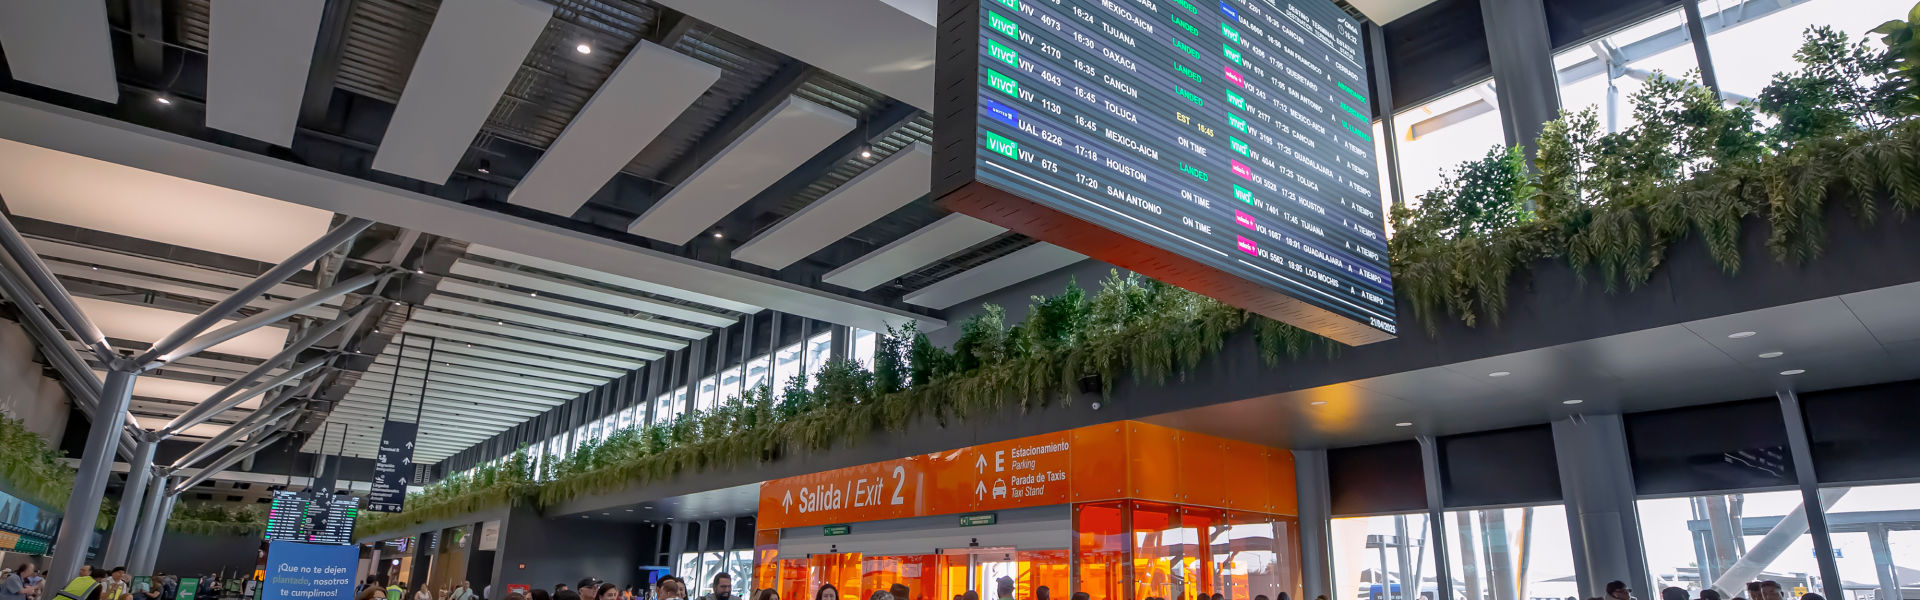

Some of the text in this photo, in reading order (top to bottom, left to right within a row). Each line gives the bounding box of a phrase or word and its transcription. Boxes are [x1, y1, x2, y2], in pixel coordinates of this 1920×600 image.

[1102, 0, 1153, 34] MEXICO-AICM
[1173, 37, 1200, 60] LANDED
[1172, 14, 1199, 37] LANDED
[1019, 1, 1204, 108] VIV 4073 16:30 OAXACA LANDED
[1073, 6, 1094, 24] 16:24
[1103, 22, 1136, 48] TIJUANA
[1174, 61, 1202, 84] LANDED
[1019, 30, 1034, 46] VIV
[1042, 42, 1061, 60] 2170
[1074, 59, 1095, 78] 16:35
[1104, 74, 1138, 99] CANCUN
[1177, 112, 1190, 126] EST
[1019, 58, 1034, 74] VIV
[1042, 70, 1061, 88] 4043
[1075, 86, 1096, 104] 16:45
[1105, 101, 1138, 125] TOLUCA
[1178, 136, 1189, 149] ON
[1191, 142, 1207, 158] TIME
[1019, 88, 1034, 104] VIV
[1042, 98, 1061, 116] 1130
[1075, 114, 1097, 133] 16:45
[1106, 128, 1159, 161] MEXICO-AICM
[1180, 161, 1209, 183] LANDED
[1019, 119, 1039, 138] UAL
[1042, 129, 1063, 148] 6226
[1076, 144, 1097, 163] 17:18
[1107, 158, 1147, 184] HOUSTON
[1182, 189, 1192, 202] ON
[1194, 195, 1210, 210] TIME
[1297, 175, 1319, 191] TOLUCA
[1019, 148, 1034, 165] VIV
[1042, 158, 1058, 174] 675
[1076, 172, 1098, 190] 17:20
[1108, 185, 1125, 201] SAN
[1126, 193, 1162, 216] ANTONIO
[1183, 216, 1194, 229] ON
[1195, 221, 1212, 236] TIME
[1299, 197, 1325, 215] HOUSTON
[1254, 198, 1264, 208] VIV
[1301, 220, 1324, 236] TIJUANA
[1256, 224, 1267, 235] VOI
[1304, 245, 1343, 267] GUADALAJARA
[1258, 248, 1269, 258] VOI
[1306, 268, 1317, 278] LOS
[1318, 273, 1339, 287] MOCHIS
[995, 450, 1005, 472] E
[1011, 442, 1070, 458] Estacionamiento
[1011, 459, 1036, 470] Parking
[798, 466, 906, 514] Salida / Exit 2
[1011, 469, 1066, 486] Parada de Taxis
[1011, 484, 1044, 498] Taxi Stand
[278, 562, 298, 573] ¡Que
[314, 566, 322, 574] te
[324, 565, 347, 576] dejen
[280, 588, 338, 599] te cumplimos!
